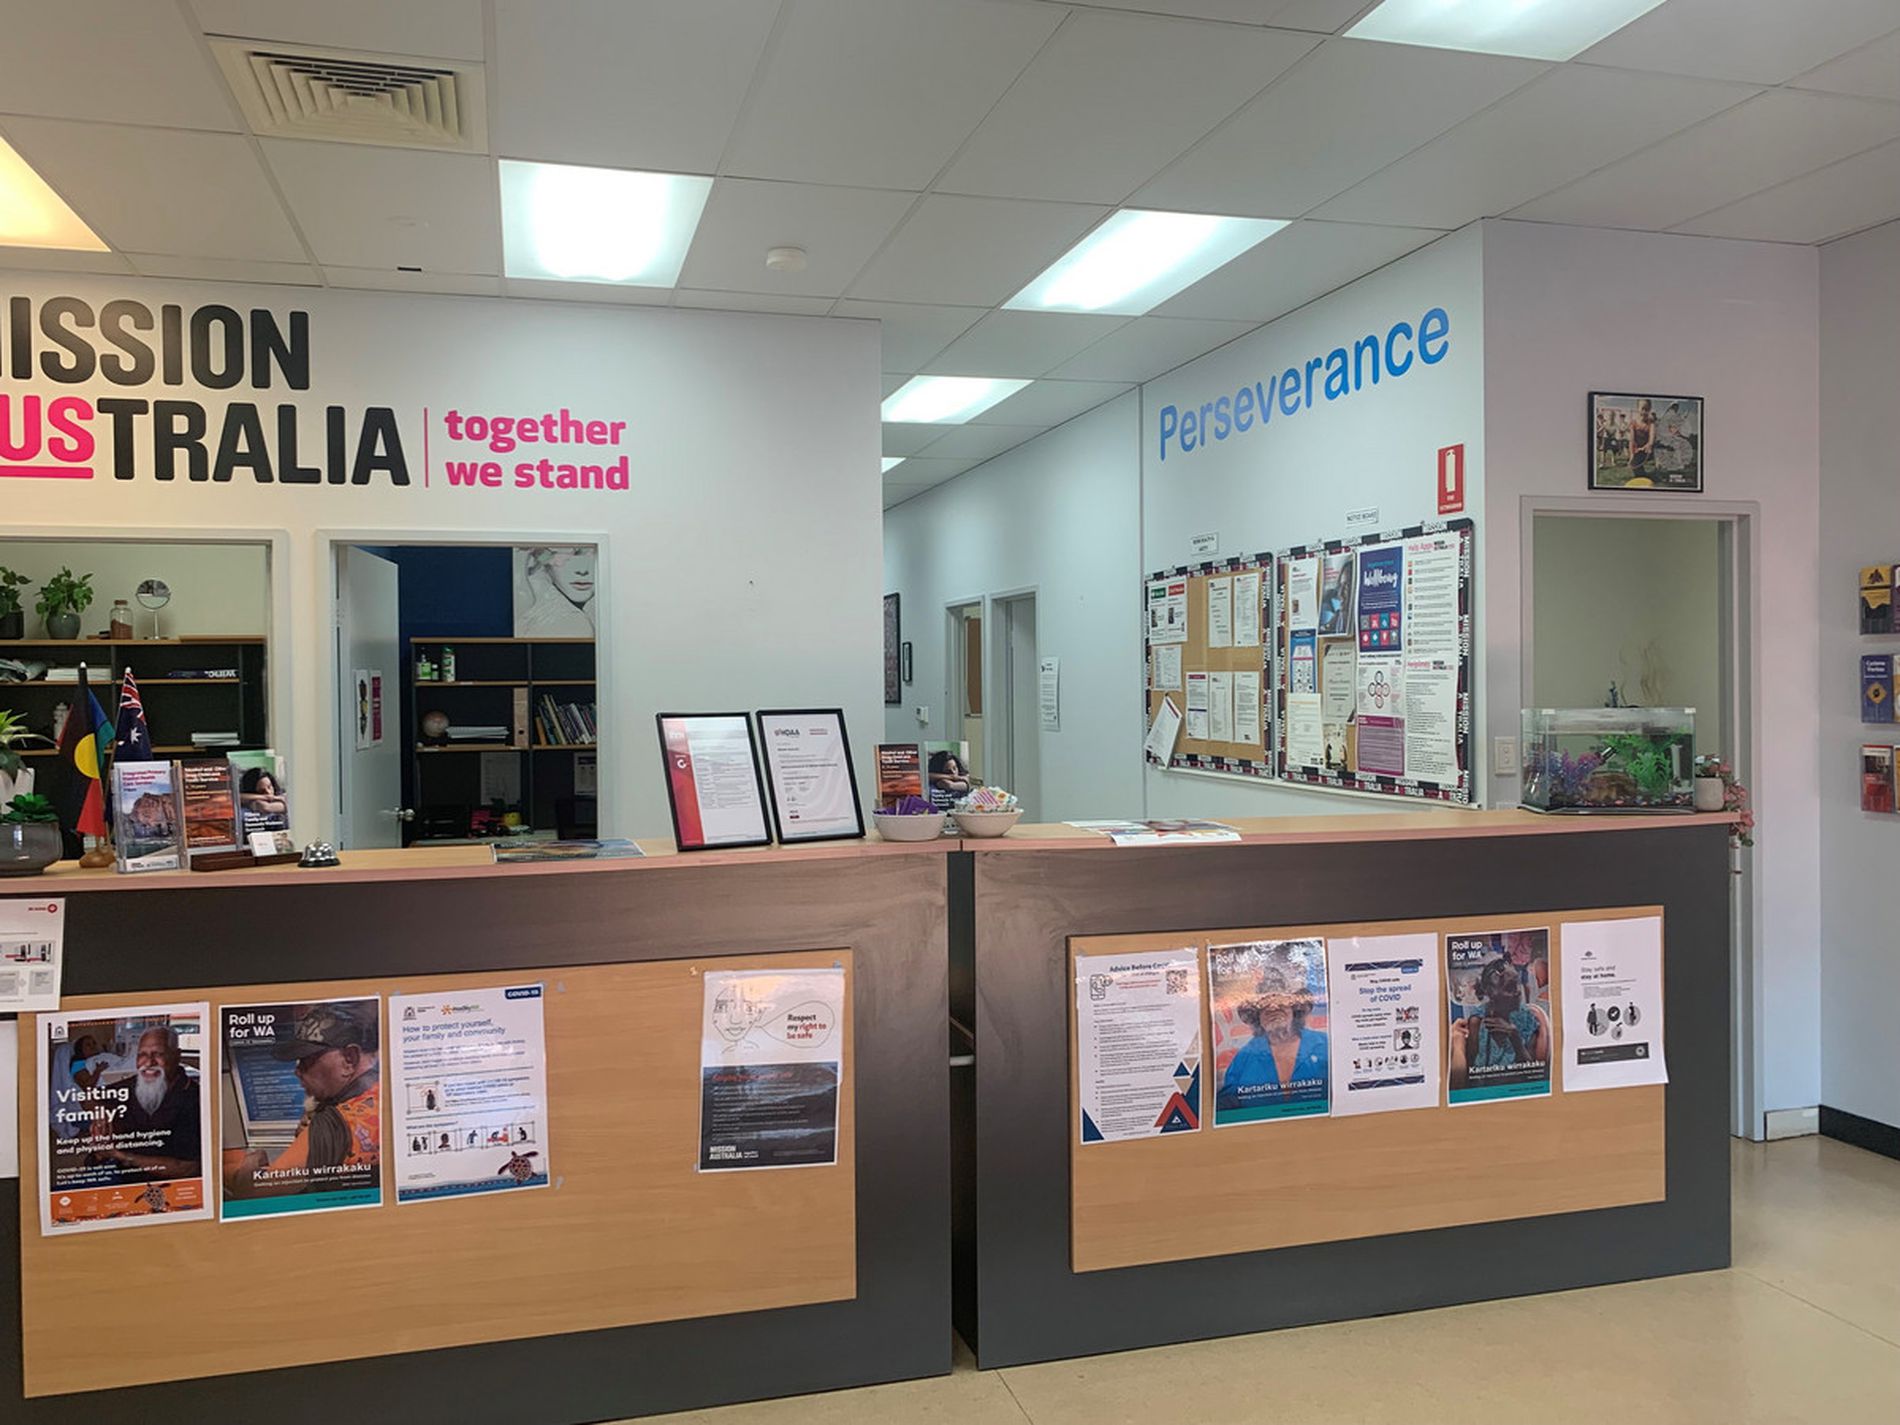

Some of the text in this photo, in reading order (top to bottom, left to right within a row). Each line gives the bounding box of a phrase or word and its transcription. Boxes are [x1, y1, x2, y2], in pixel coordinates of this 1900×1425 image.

[0, 296, 310, 390] ISSION
[1159, 307, 1450, 462] Perseverance
[444, 408, 626, 454] together
[446, 455, 630, 490] we stand
[1451, 941, 1483, 951] Roll up
[1452, 951, 1466, 960] for
[1109, 963, 1152, 972] Advice Before
[507, 988, 540, 998] COVID-19
[1359, 987, 1375, 995] Stop
[1388, 984, 1412, 993] spread
[1369, 993, 1401, 1003] of COVID
[229, 1013, 276, 1026] Roll up
[787, 1013, 817, 1023] Respect
[229, 1025, 276, 1038] for WA
[402, 1026, 421, 1034] How
[432, 1021, 460, 1032] protect
[787, 1022, 827, 1032] my right to
[422, 1030, 446, 1041] family
[447, 1029, 463, 1038] and
[786, 1031, 813, 1040] be safe
[1469, 1064, 1506, 1074] Kartariku
[1507, 1060, 1546, 1070] wirrakaku
[1237, 1083, 1278, 1094] Kartariku
[1280, 1078, 1323, 1089] wirrakaku
[56, 1086, 129, 1102] Visiting
[56, 1104, 128, 1123] family?
[56, 1137, 80, 1146] Keep
[95, 1134, 110, 1142] the
[112, 1131, 135, 1140] hand
[136, 1129, 171, 1140] hygiene
[56, 1146, 74, 1155] and
[76, 1143, 114, 1154] physical
[253, 1162, 372, 1180] Kartariku wirrakaku
